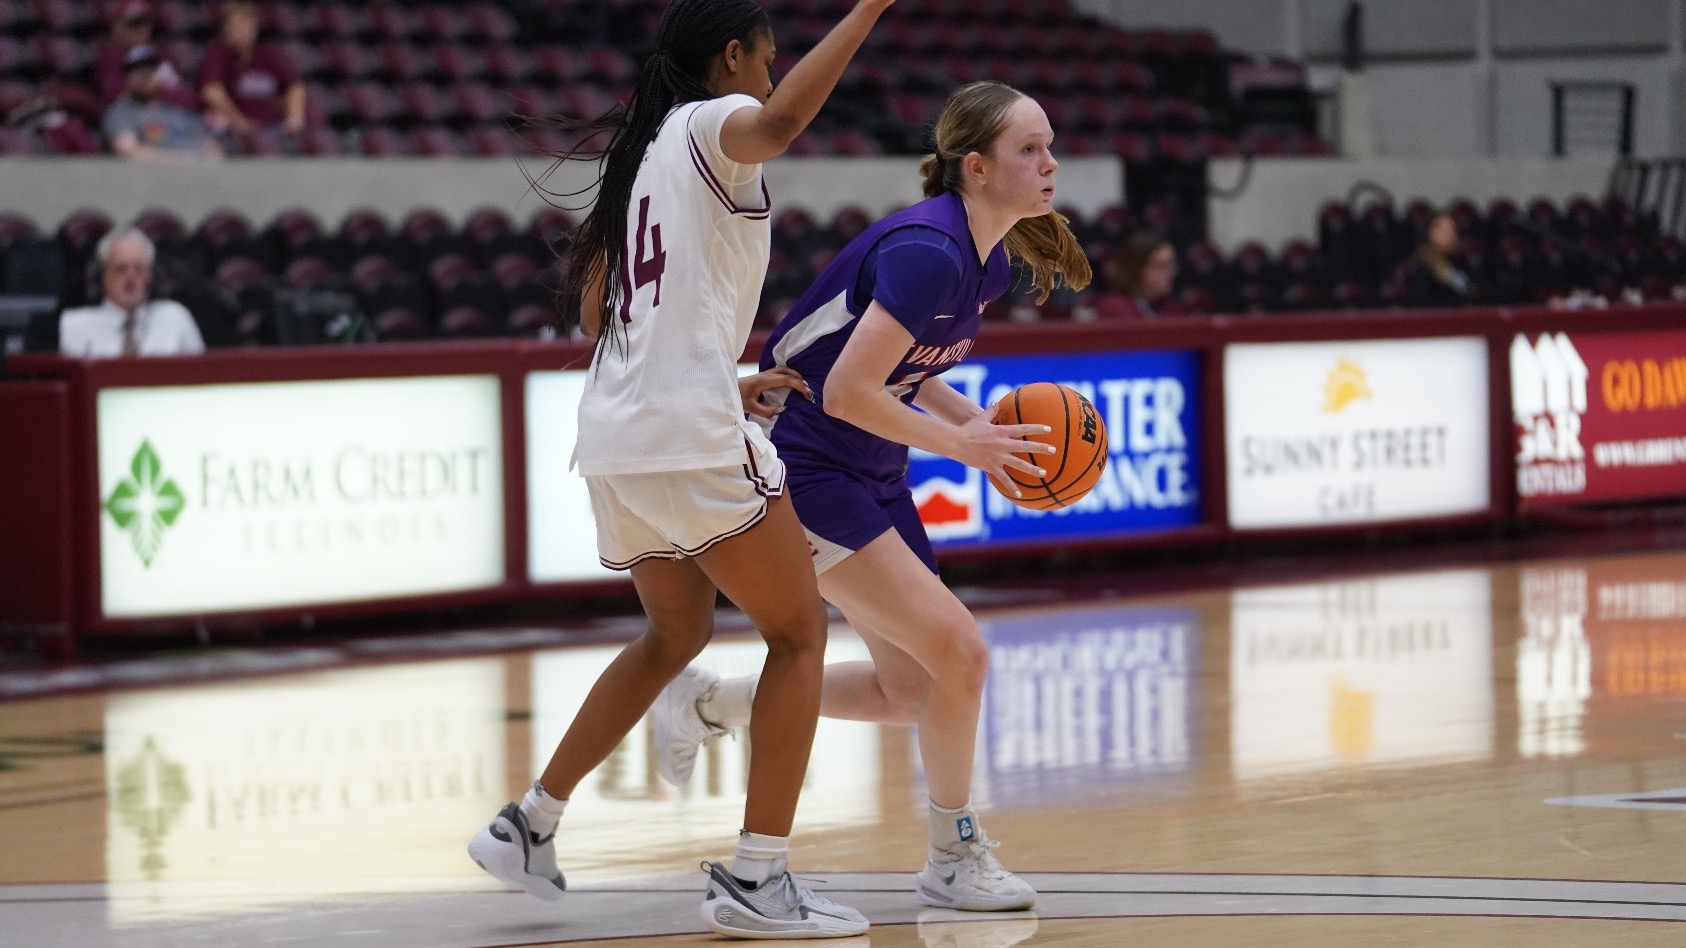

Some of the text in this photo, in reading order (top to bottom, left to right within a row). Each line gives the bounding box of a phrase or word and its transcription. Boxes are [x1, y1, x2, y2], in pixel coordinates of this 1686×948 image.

[199, 442, 490, 511] FARM CREDIT
[1242, 425, 1448, 478] SUNNY STREET
[241, 510, 448, 554] ILLINOIS
